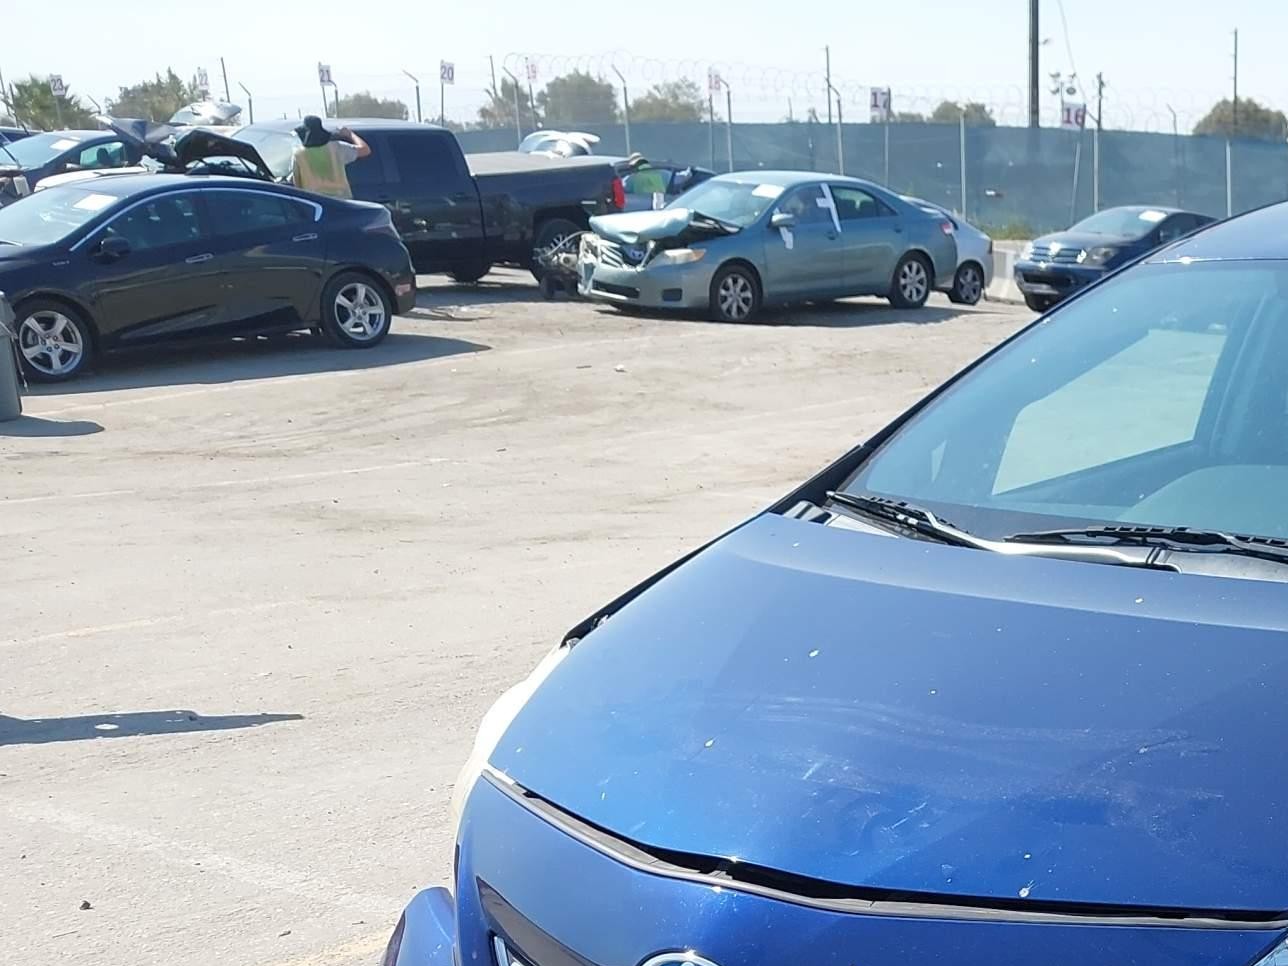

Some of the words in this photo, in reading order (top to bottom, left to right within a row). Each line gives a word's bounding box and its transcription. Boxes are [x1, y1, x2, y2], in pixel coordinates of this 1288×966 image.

[319, 69, 331, 82] 21
[440, 65, 454, 82] 20
[51, 79, 64, 92] 23
[871, 91, 888, 109] 17
[1063, 107, 1085, 126] 16
